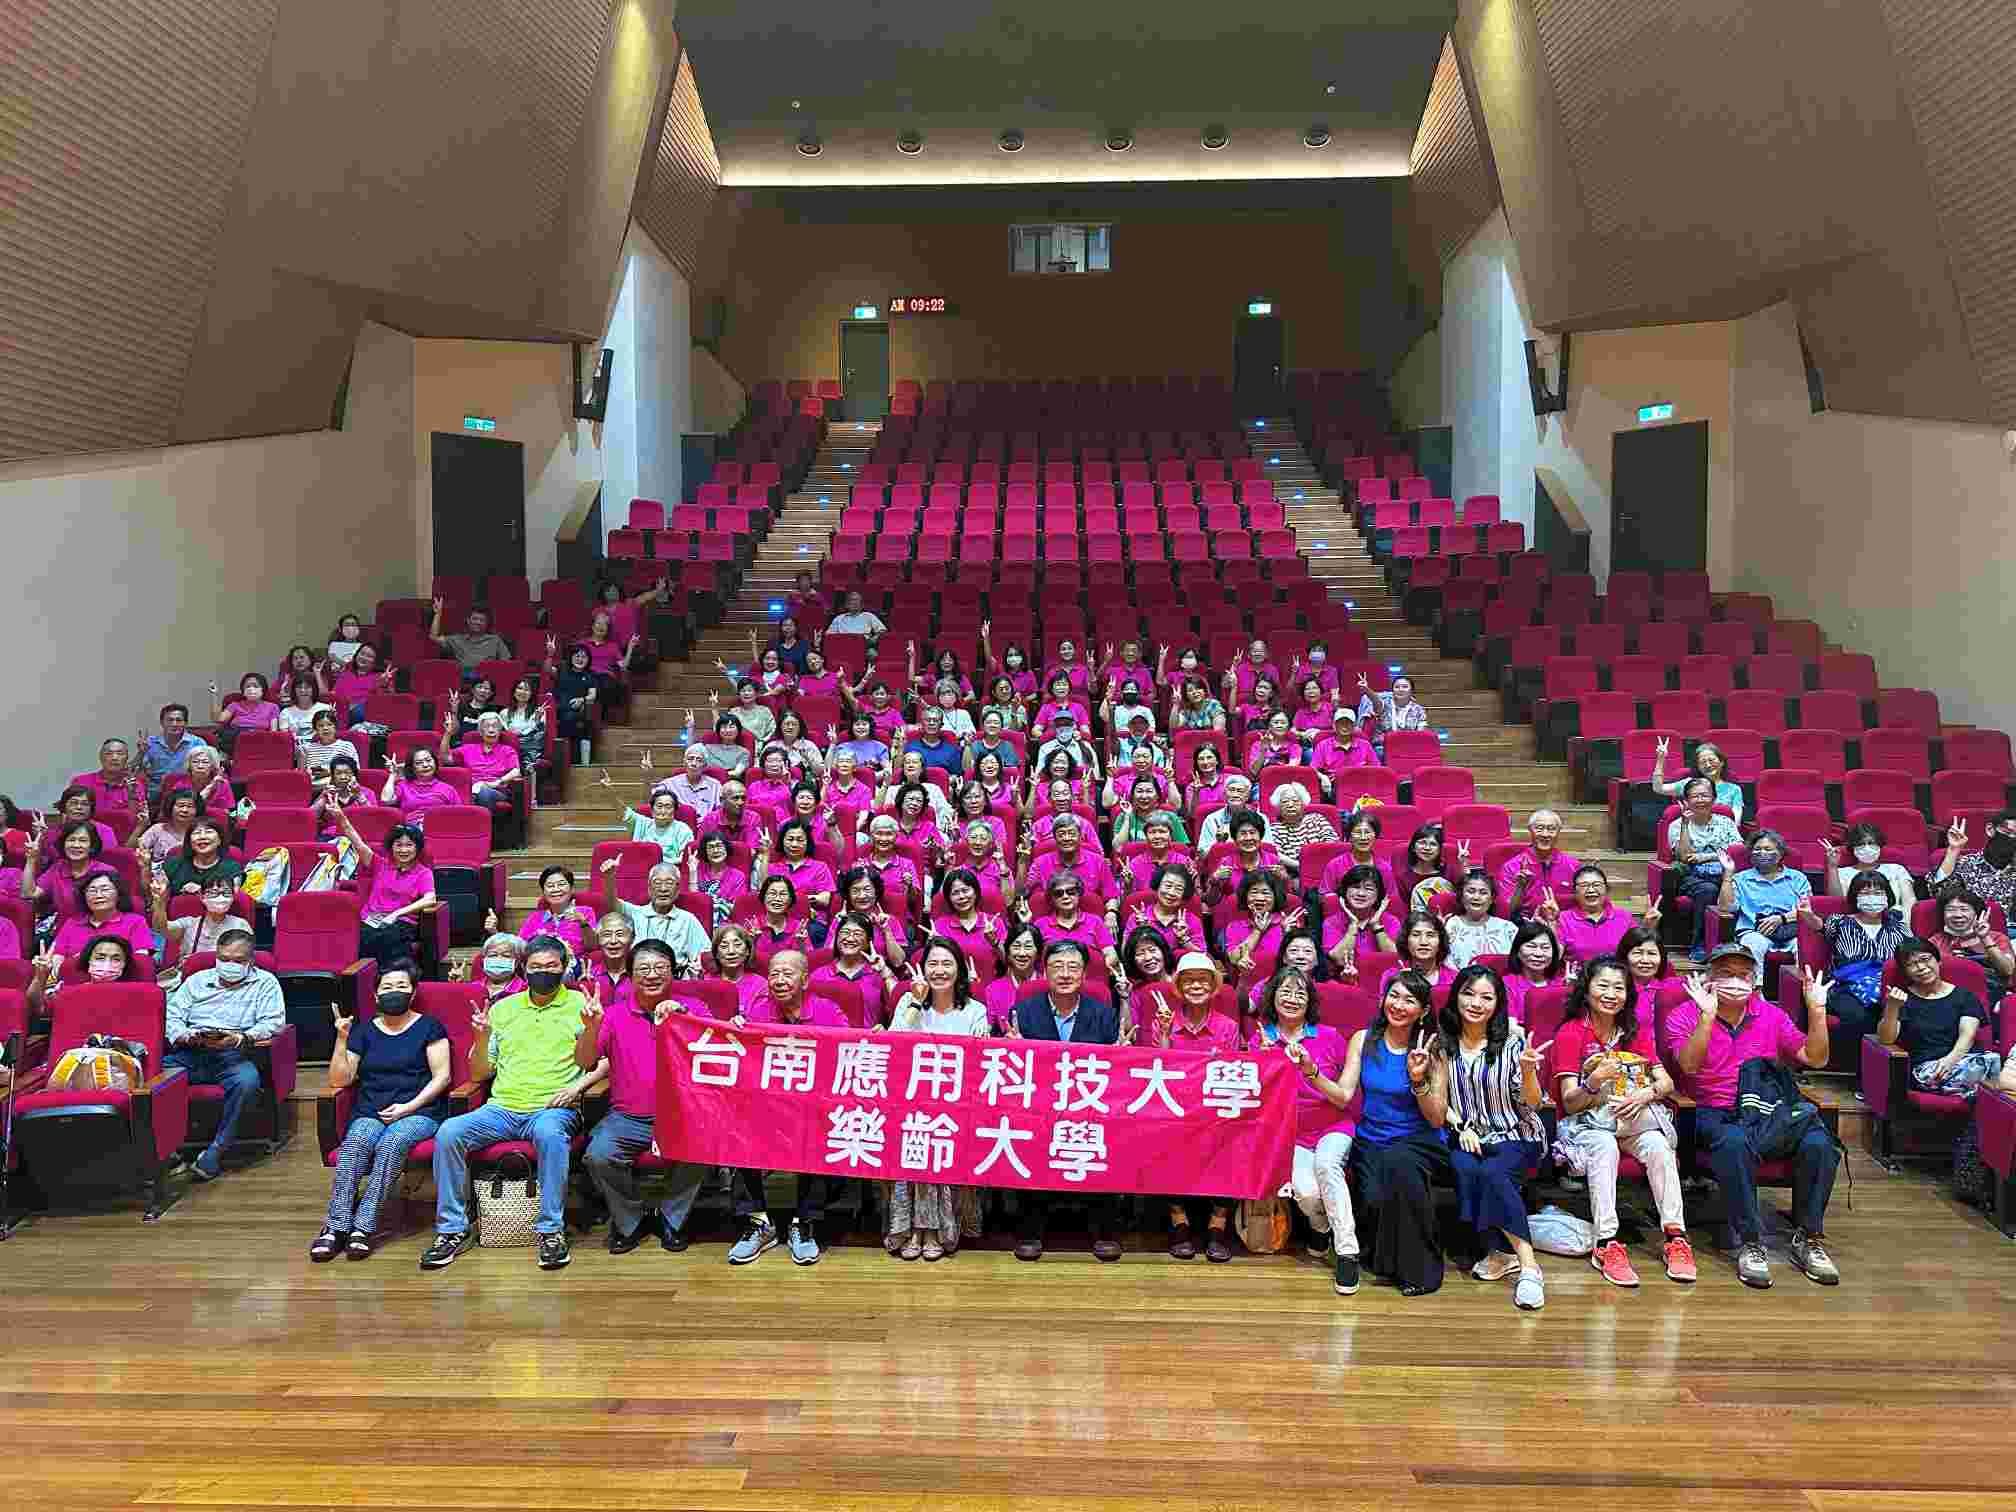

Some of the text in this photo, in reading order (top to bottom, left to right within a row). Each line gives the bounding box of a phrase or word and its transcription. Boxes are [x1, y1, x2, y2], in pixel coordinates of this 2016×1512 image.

[910, 299, 945, 311] 09:22
[687, 1028, 1262, 1119] 台南應用科技大學
[825, 1104, 1108, 1182] 樂齡大學
